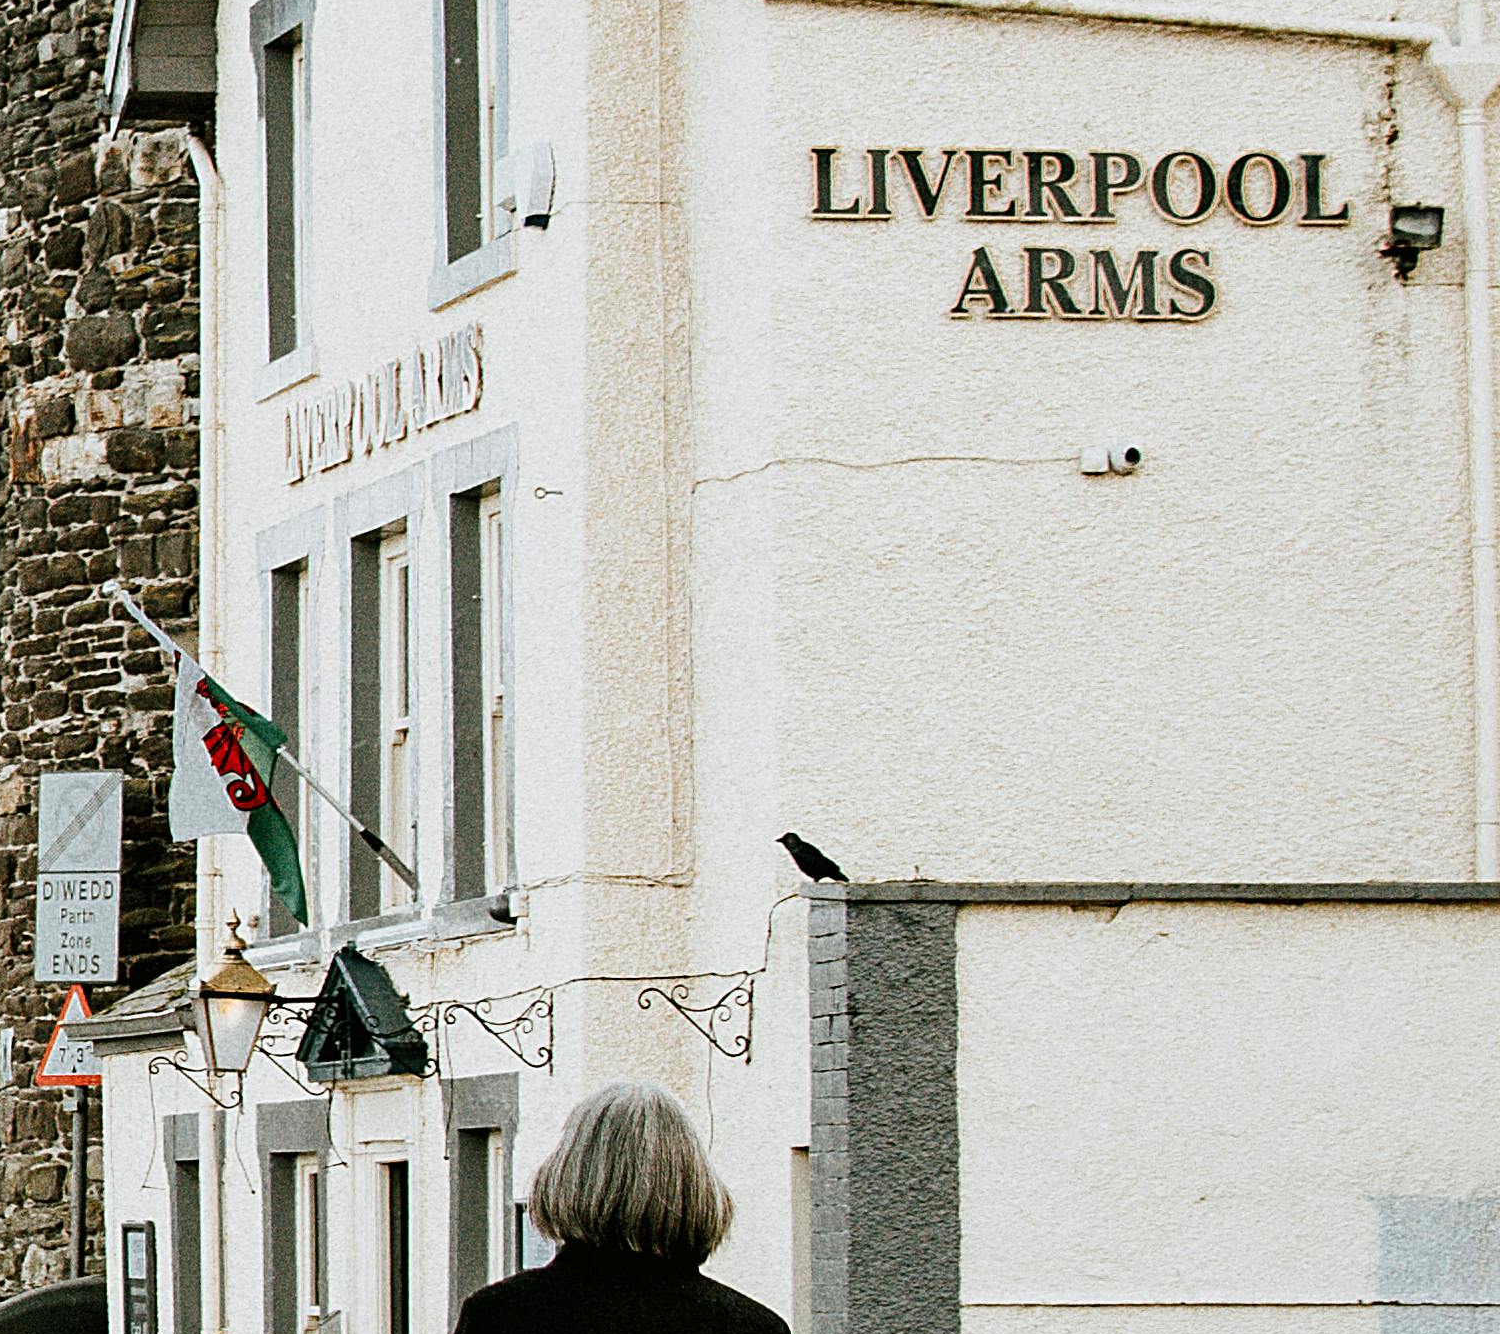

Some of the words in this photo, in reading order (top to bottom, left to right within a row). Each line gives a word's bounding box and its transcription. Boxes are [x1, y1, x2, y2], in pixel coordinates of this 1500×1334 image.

[810, 147, 1352, 227] LIVERPOOL
[950, 246, 1219, 321] ARMS
[284, 358, 408, 487] LIVERPOOL
[411, 321, 484, 433] ARMS
[42, 880, 114, 901] DIWEDD
[60, 907, 96, 924] Parth
[60, 932, 92, 949] Zone
[52, 954, 100, 975] ENDS
